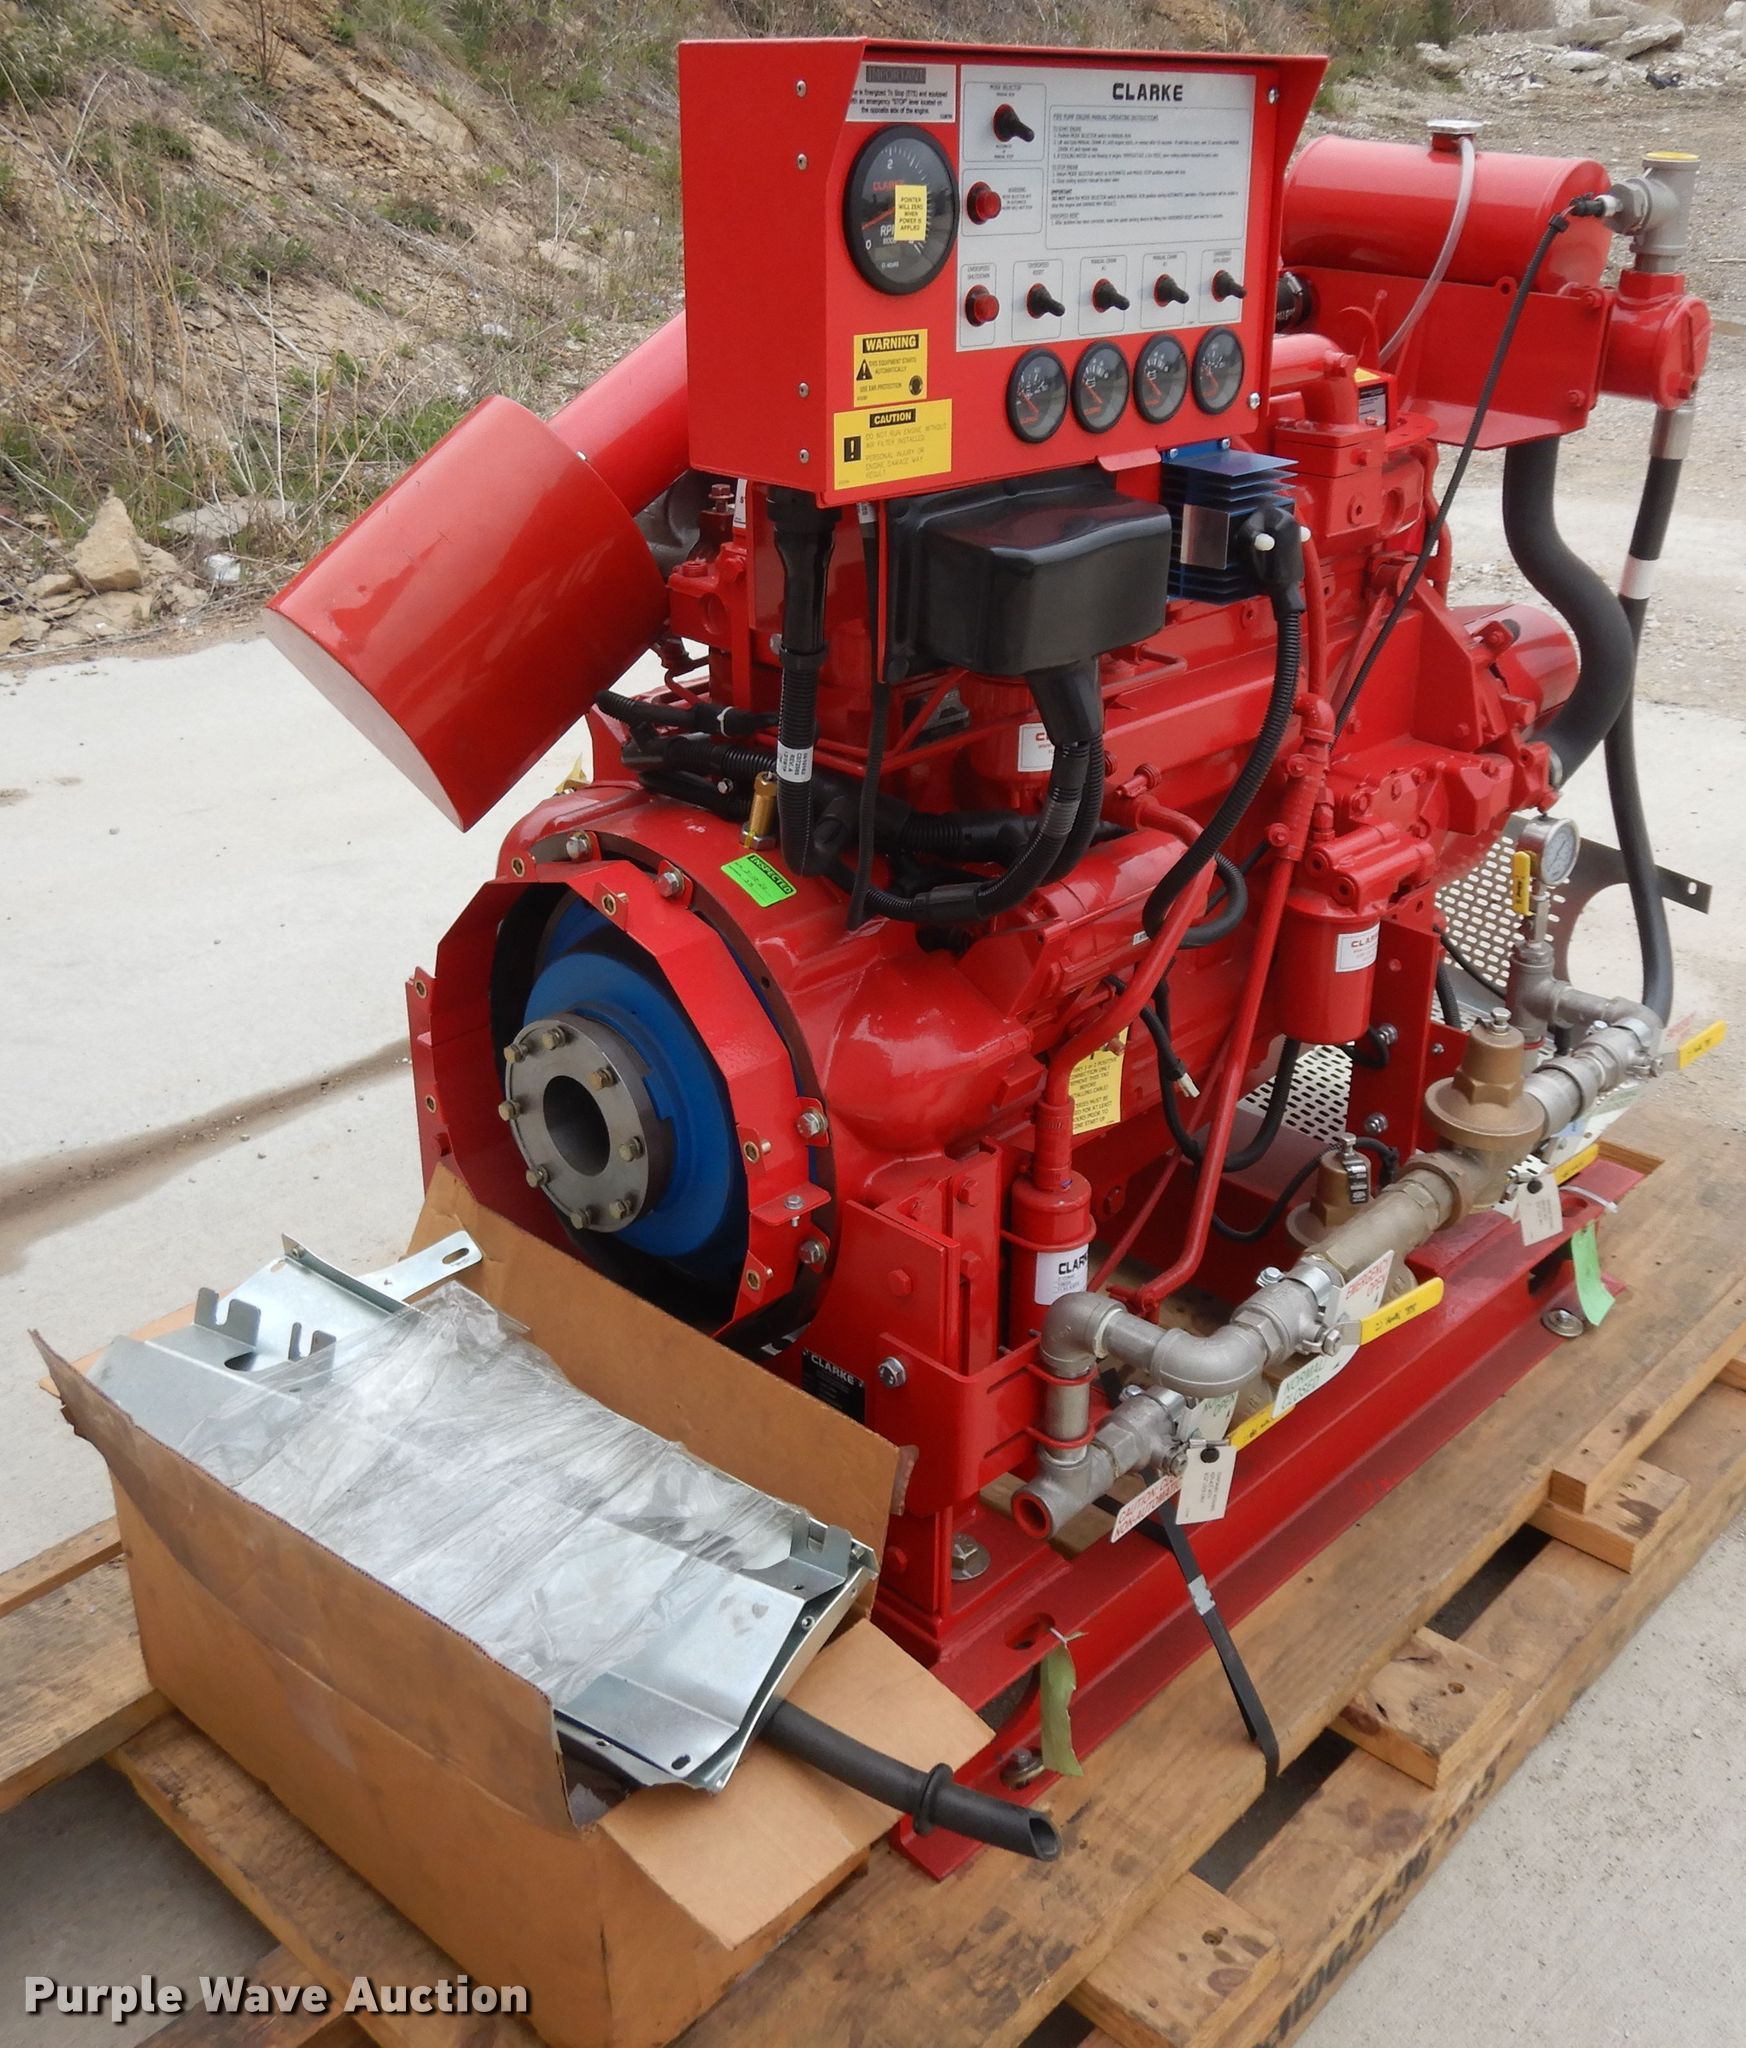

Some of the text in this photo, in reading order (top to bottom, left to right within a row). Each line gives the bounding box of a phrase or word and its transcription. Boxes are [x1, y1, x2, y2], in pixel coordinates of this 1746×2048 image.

[1112, 82, 1183, 102] CLARKE
[887, 159, 893, 170] 2
[866, 239, 872, 250] 0
[866, 335, 917, 352] WARNING
[875, 366, 907, 375] AUTOMATICALLY
[874, 412, 912, 425] CAUTION
[904, 427, 922, 435] ENGINE
[925, 423, 947, 432] WITHOUT
[877, 439, 895, 447] FILTER
[898, 435, 925, 444] INSTALLED
[866, 452, 893, 462] PERSONAL
[866, 461, 883, 471] ENGINE
[750, 856, 792, 894] INSPECTED
[1351, 935, 1378, 948] CLAR
[811, 1354, 855, 1386] CLARKE
